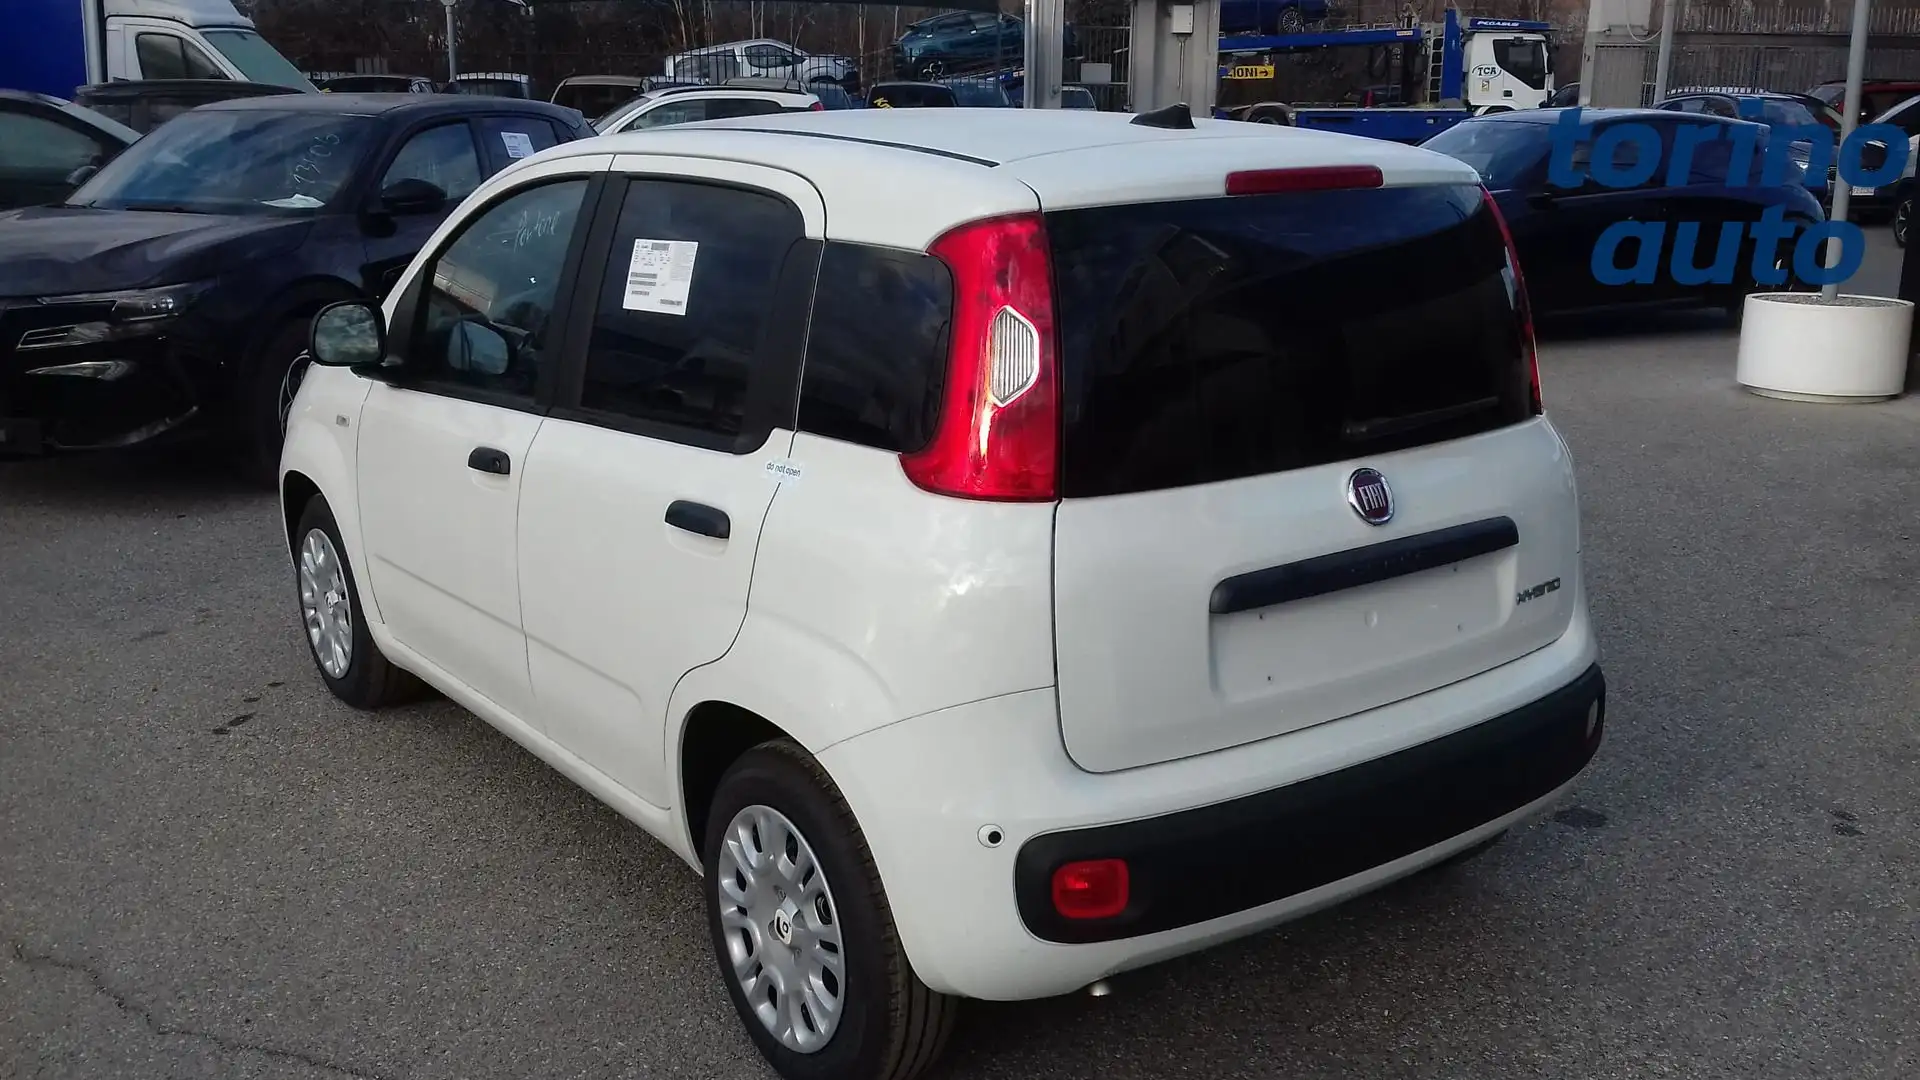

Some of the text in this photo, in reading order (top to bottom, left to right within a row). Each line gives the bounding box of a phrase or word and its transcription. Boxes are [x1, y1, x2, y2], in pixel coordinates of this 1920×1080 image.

[1231, 67, 1258, 78] IONI
[1477, 67, 1497, 77] TCA
[766, 462, 801, 477] do not open
[1358, 482, 1386, 511] FIAT
